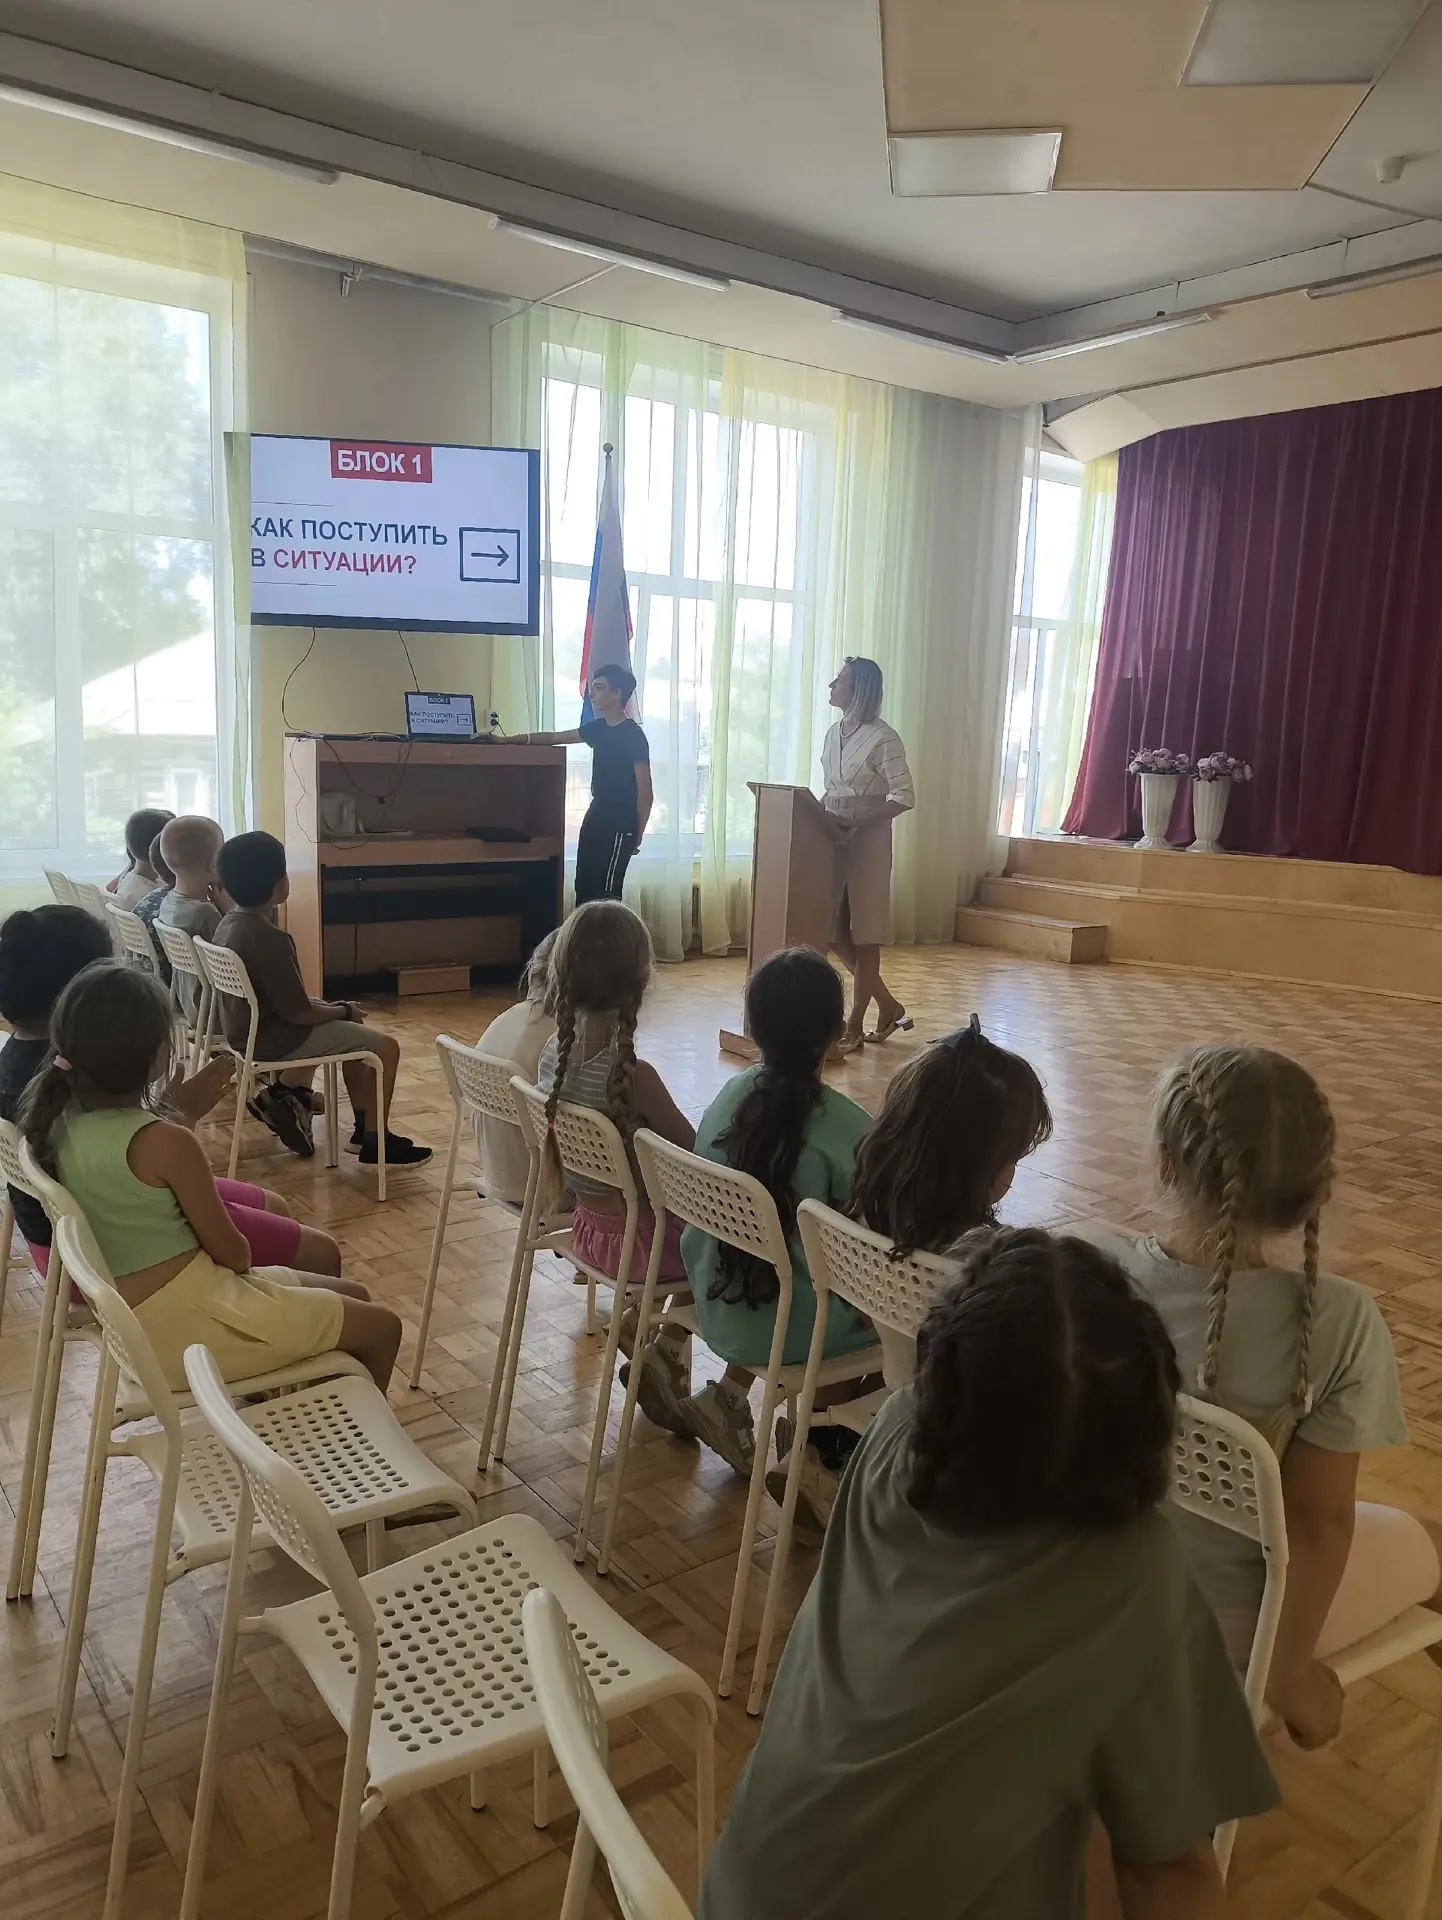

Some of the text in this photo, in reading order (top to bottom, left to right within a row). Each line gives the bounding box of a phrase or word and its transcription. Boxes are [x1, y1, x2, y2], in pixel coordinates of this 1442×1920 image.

[337, 449, 422, 475] БЛОК 1
[250, 516, 448, 546] КАК ПОСТУПИТЬ
[251, 547, 418, 576] В СИТУАЦИИ?
